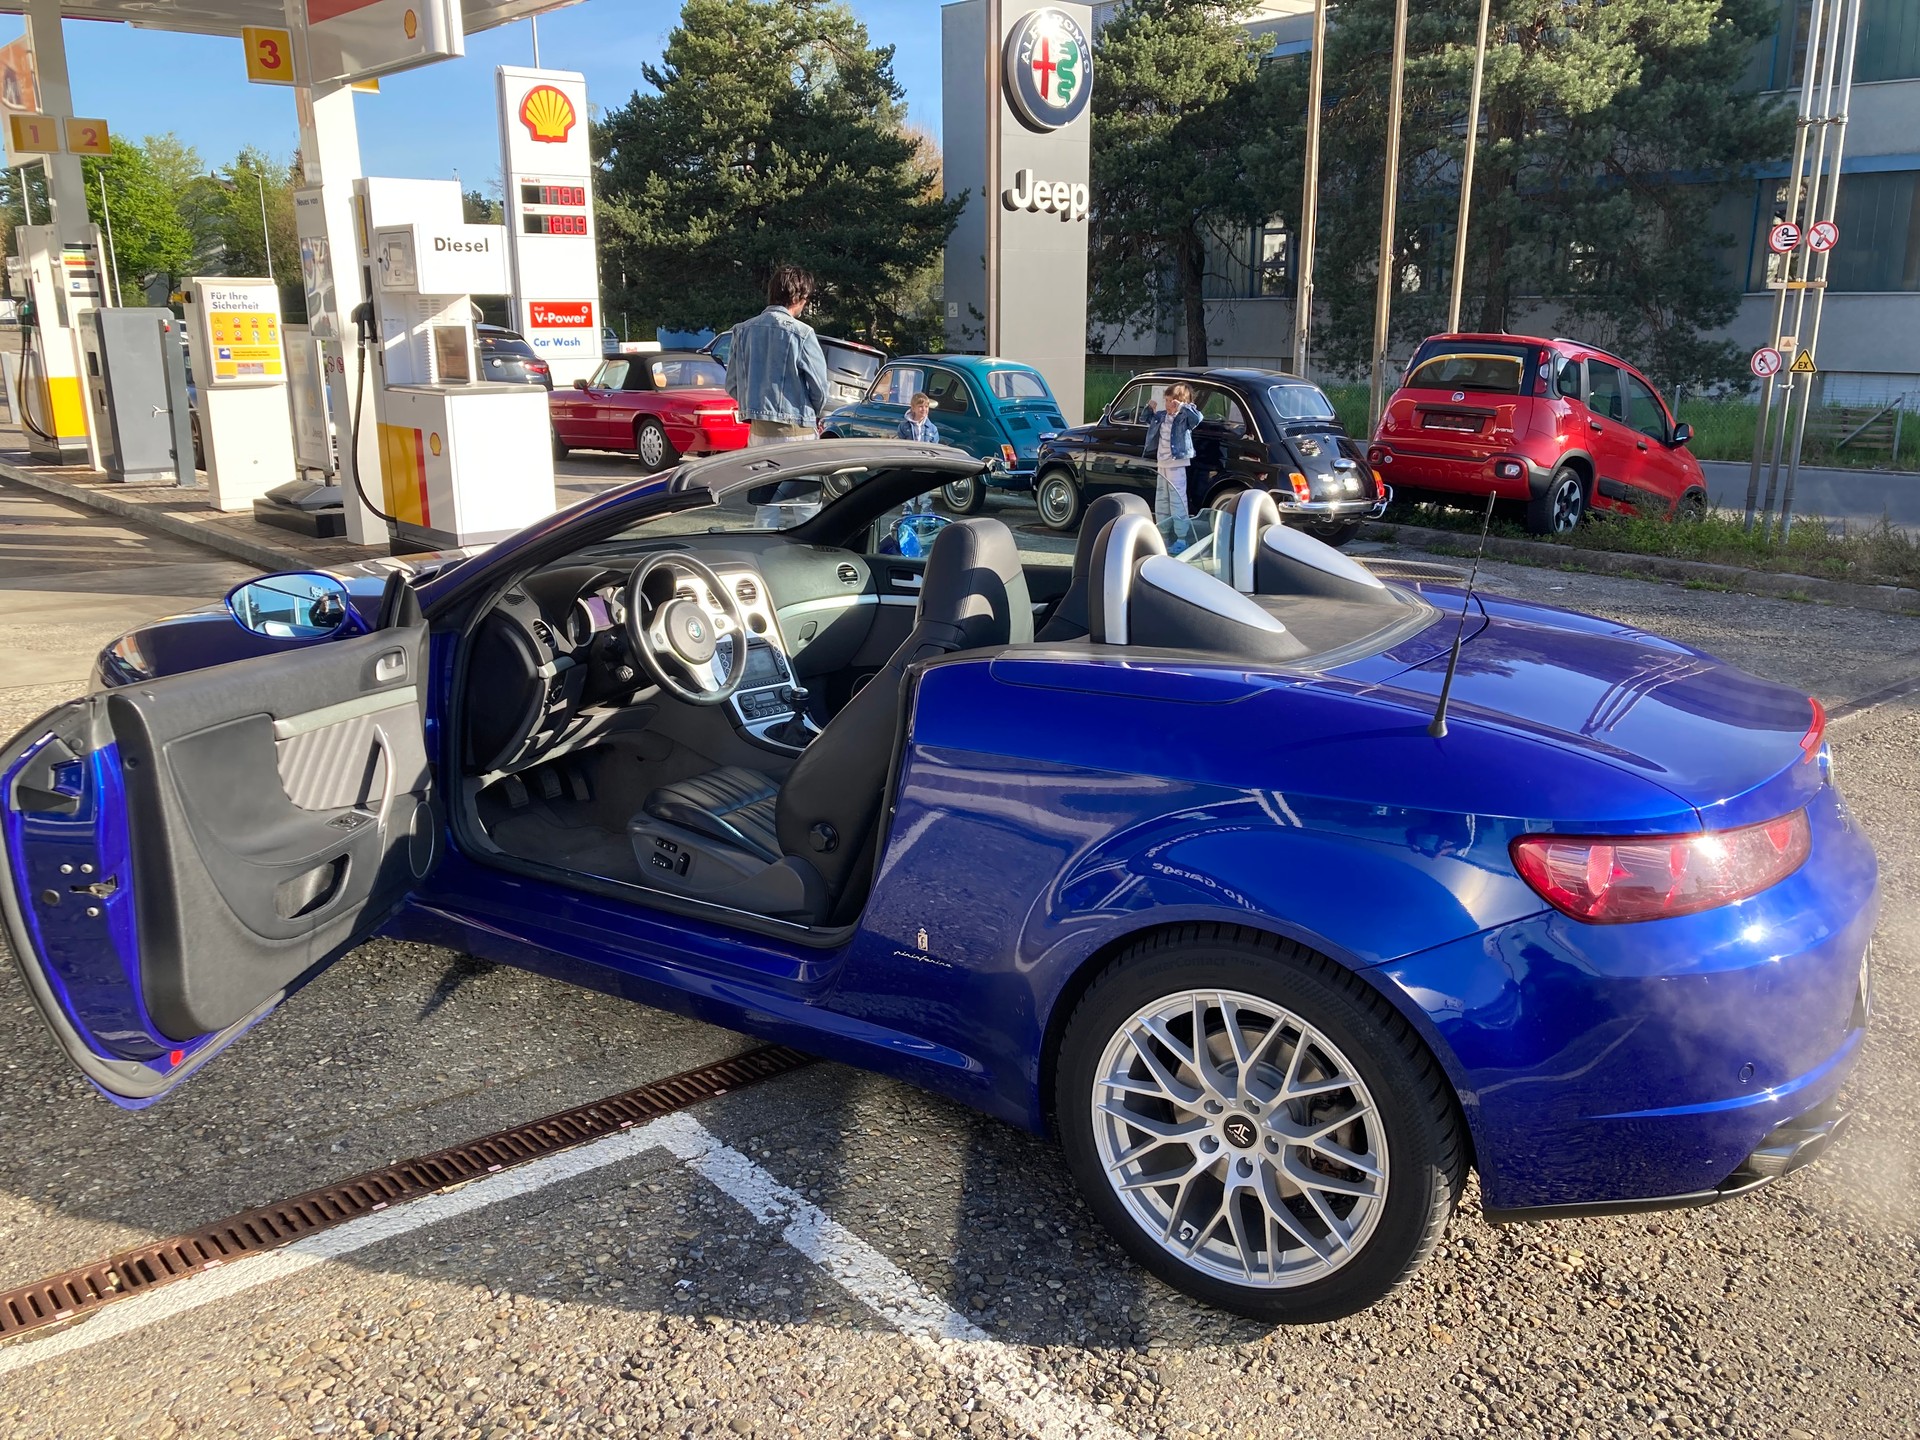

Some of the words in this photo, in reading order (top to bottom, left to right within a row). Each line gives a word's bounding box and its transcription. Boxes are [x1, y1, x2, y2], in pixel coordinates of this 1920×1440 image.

[259, 39, 281, 69] 3
[29, 125, 39, 144] 1
[81, 128, 98, 147] 2
[545, 186, 584, 205] 179.0
[1012, 169, 1089, 219] Jeep
[547, 216, 586, 234] 189.9
[434, 237, 489, 252] Diesel
[383, 247, 390, 271] 3
[210, 292, 227, 300] Für
[229, 292, 248, 300] Ihre
[212, 301, 259, 310] Sicherheit
[534, 312, 586, 323] V-Power
[533, 338, 550, 347] Car
[552, 337, 581, 347] Wash
[1798, 362, 1809, 370] EX
